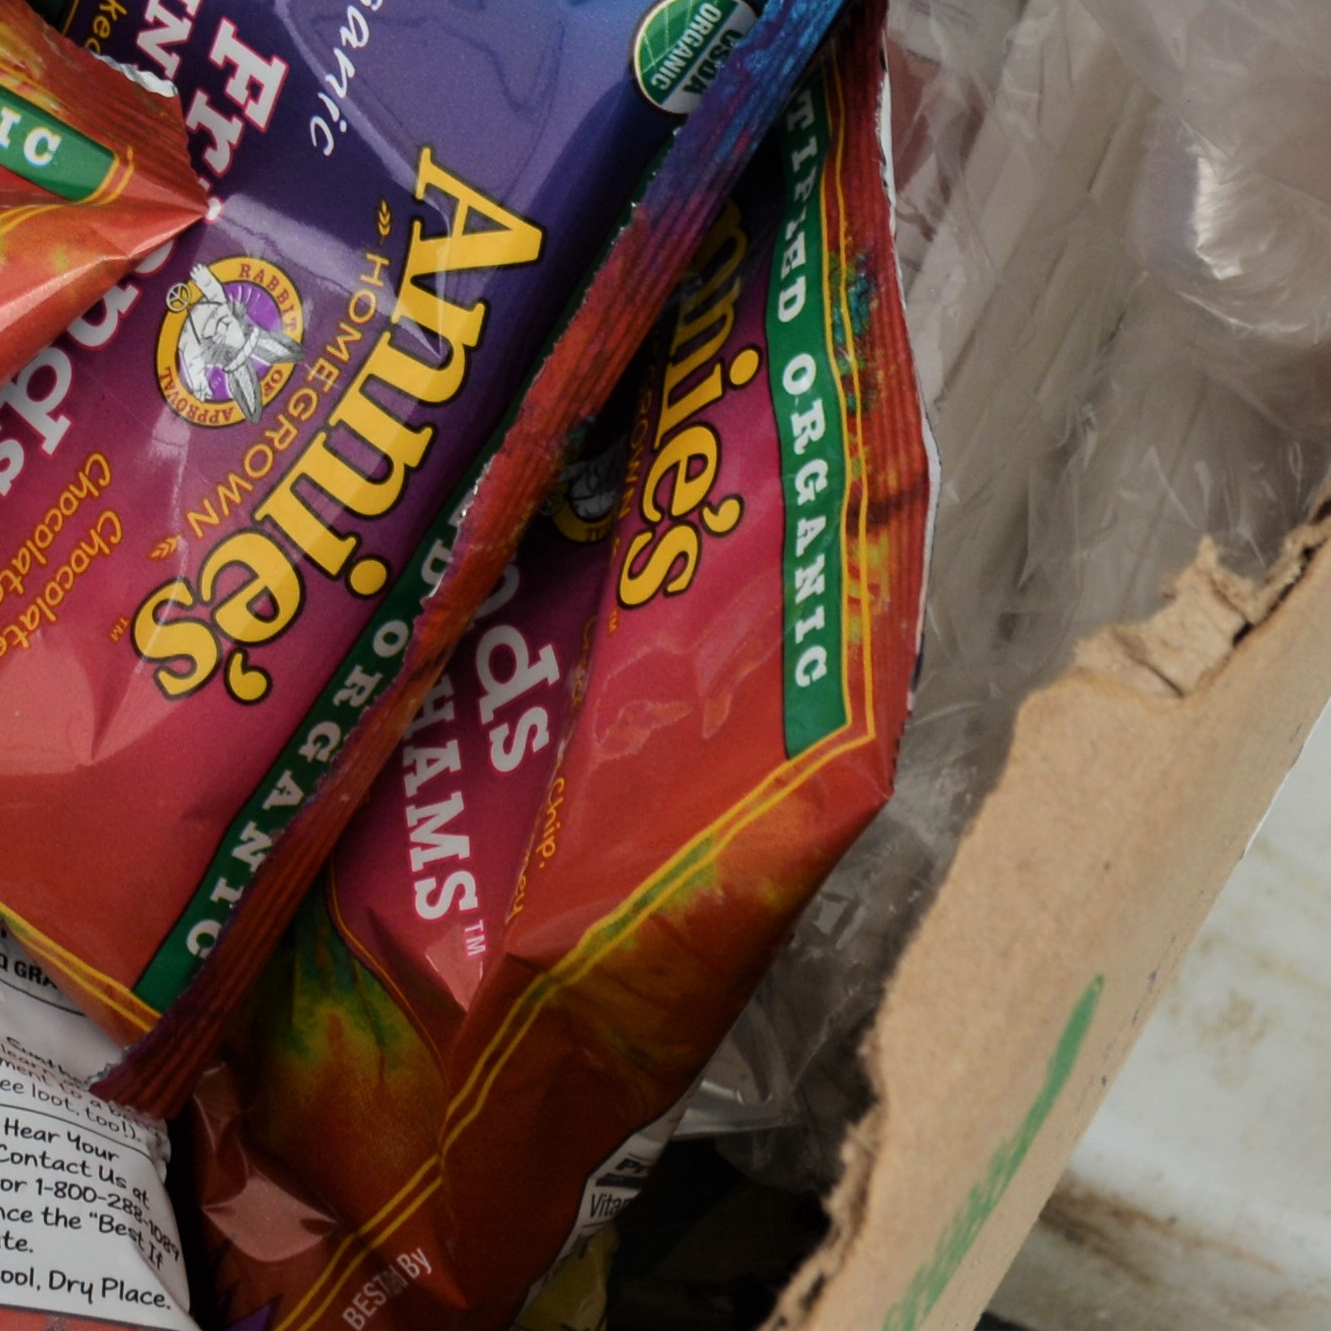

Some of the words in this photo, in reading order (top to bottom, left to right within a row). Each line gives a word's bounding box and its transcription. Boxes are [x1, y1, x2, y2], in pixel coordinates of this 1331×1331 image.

[649, 1, 723, 92] ORGANIC
[239, 263, 299, 333] RABBIT
[132, 144, 544, 704] Annie's
[161, 364, 234, 427] APPROVAL
[186, 252, 390, 539] HOMEGROWN
[780, 350, 830, 690] ORGANIC
[2, 1116, 62, 1145] Hear
[66, 1129, 121, 1164] Your
[0, 1178, 29, 1194] or
[97, 1164, 128, 1191] Us
[40, 1204, 84, 1230] the
[48, 1269, 94, 1305] Dry
[100, 1277, 173, 1312] Place.
